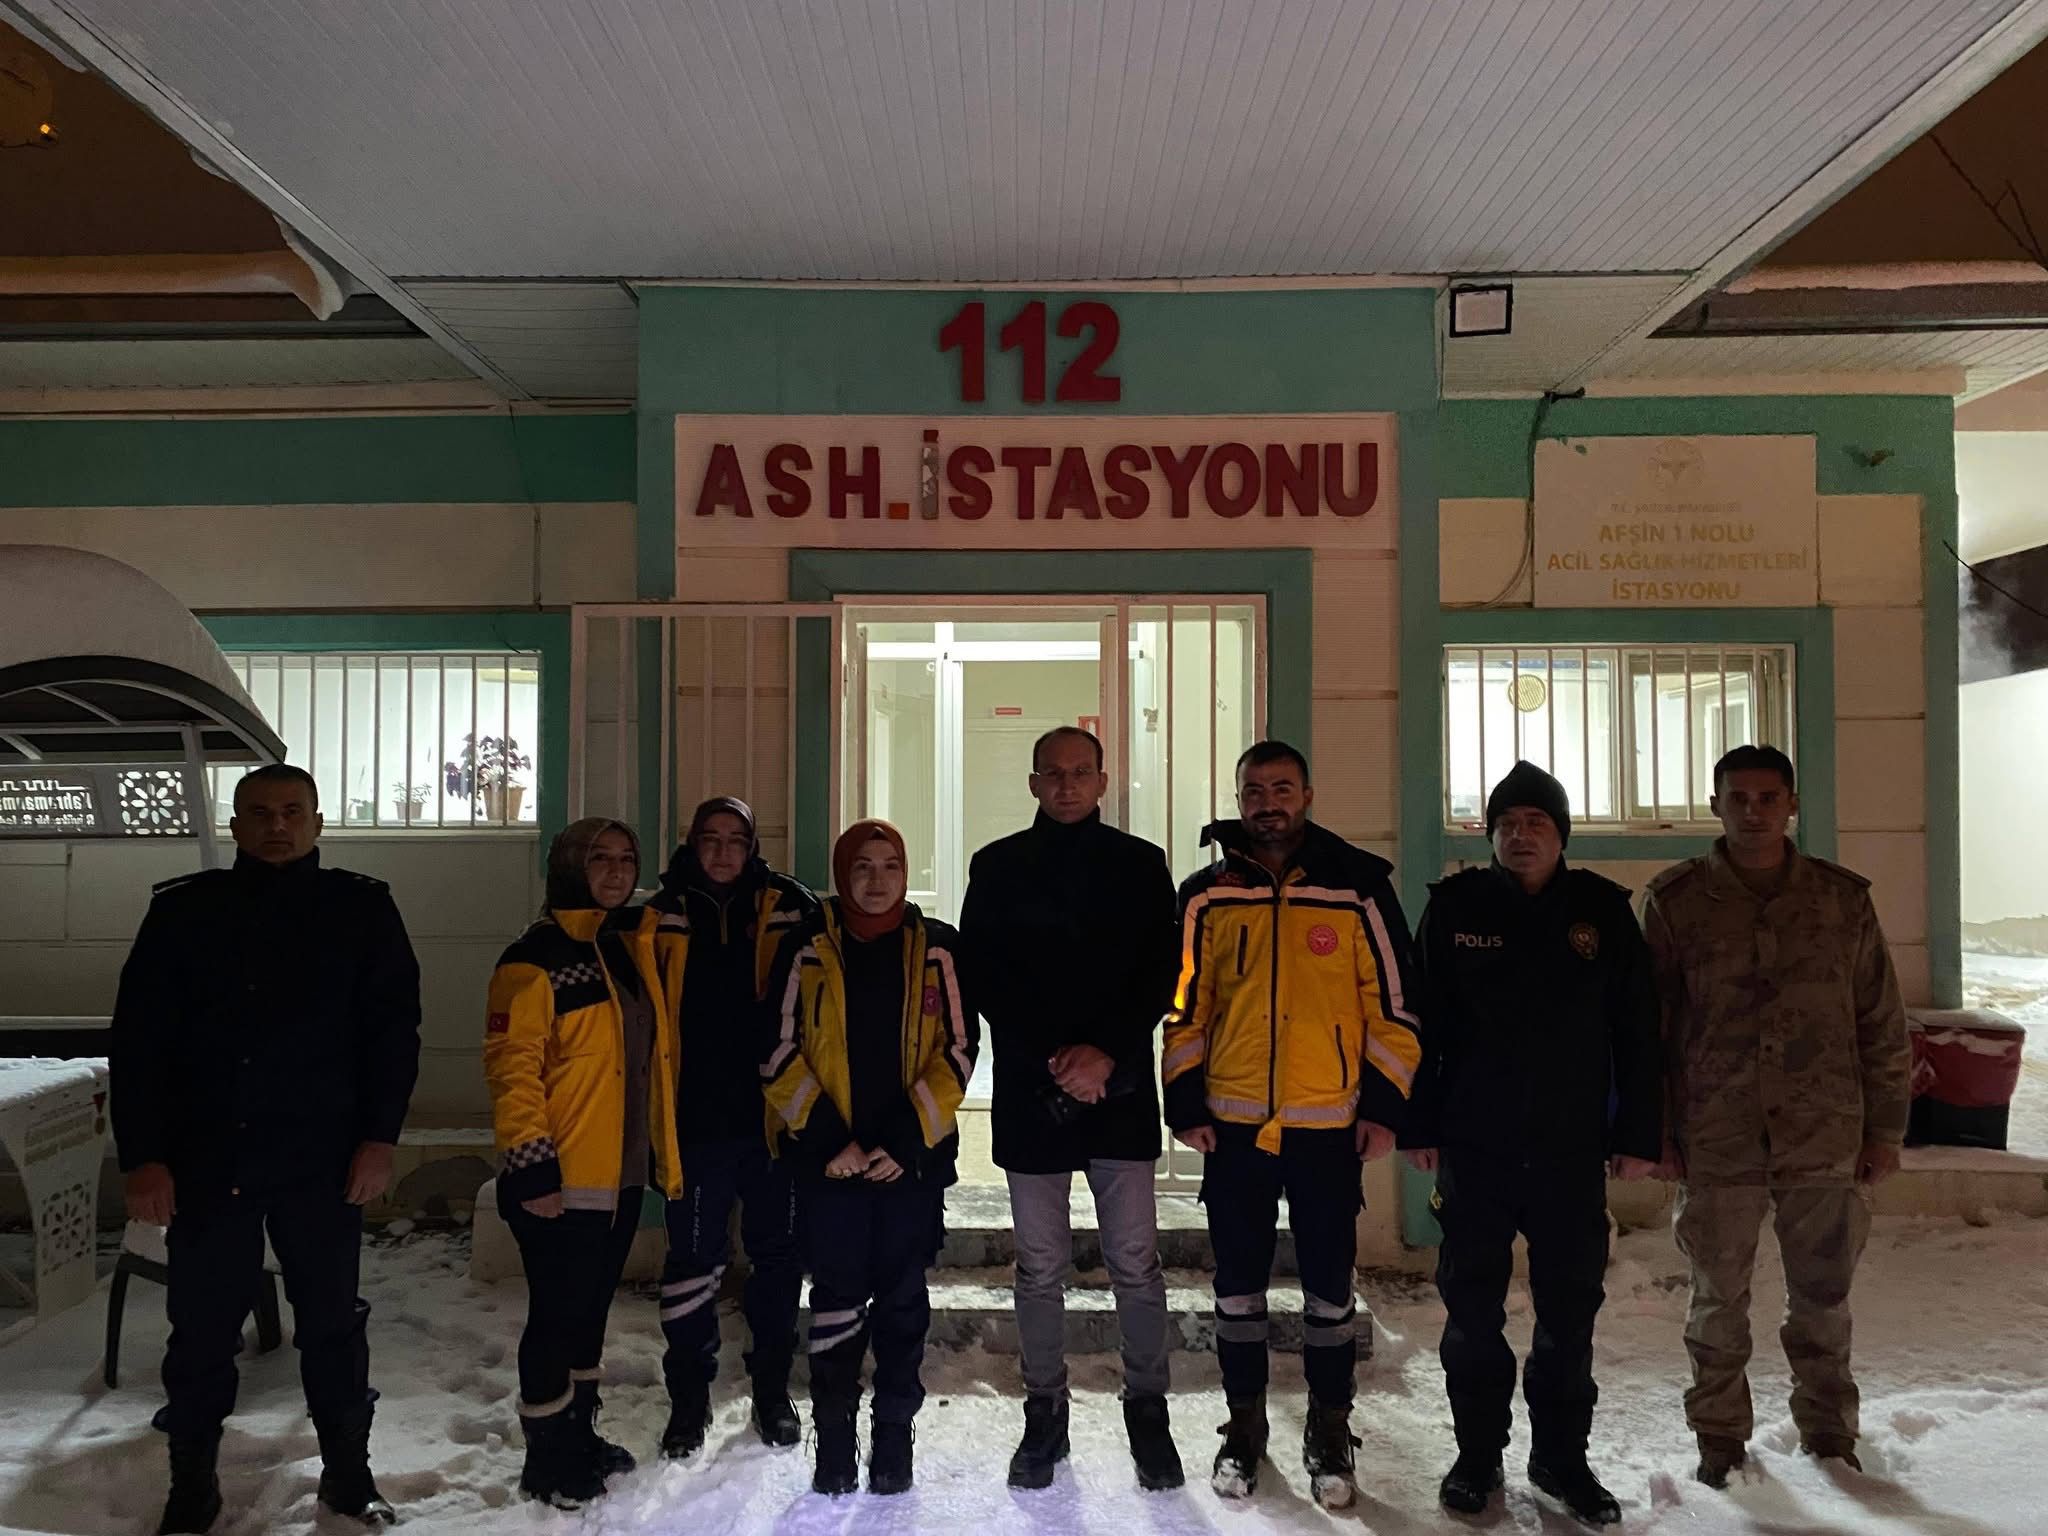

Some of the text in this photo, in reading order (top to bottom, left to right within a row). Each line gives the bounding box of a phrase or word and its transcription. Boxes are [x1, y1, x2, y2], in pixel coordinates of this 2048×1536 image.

[939, 301, 1121, 404] 112
[1599, 521, 1665, 546] AFŞİN
[1691, 523, 1755, 544] NOLU
[1547, 551, 1592, 570] ACİL
[1612, 579, 1741, 600] İSTASYONU
